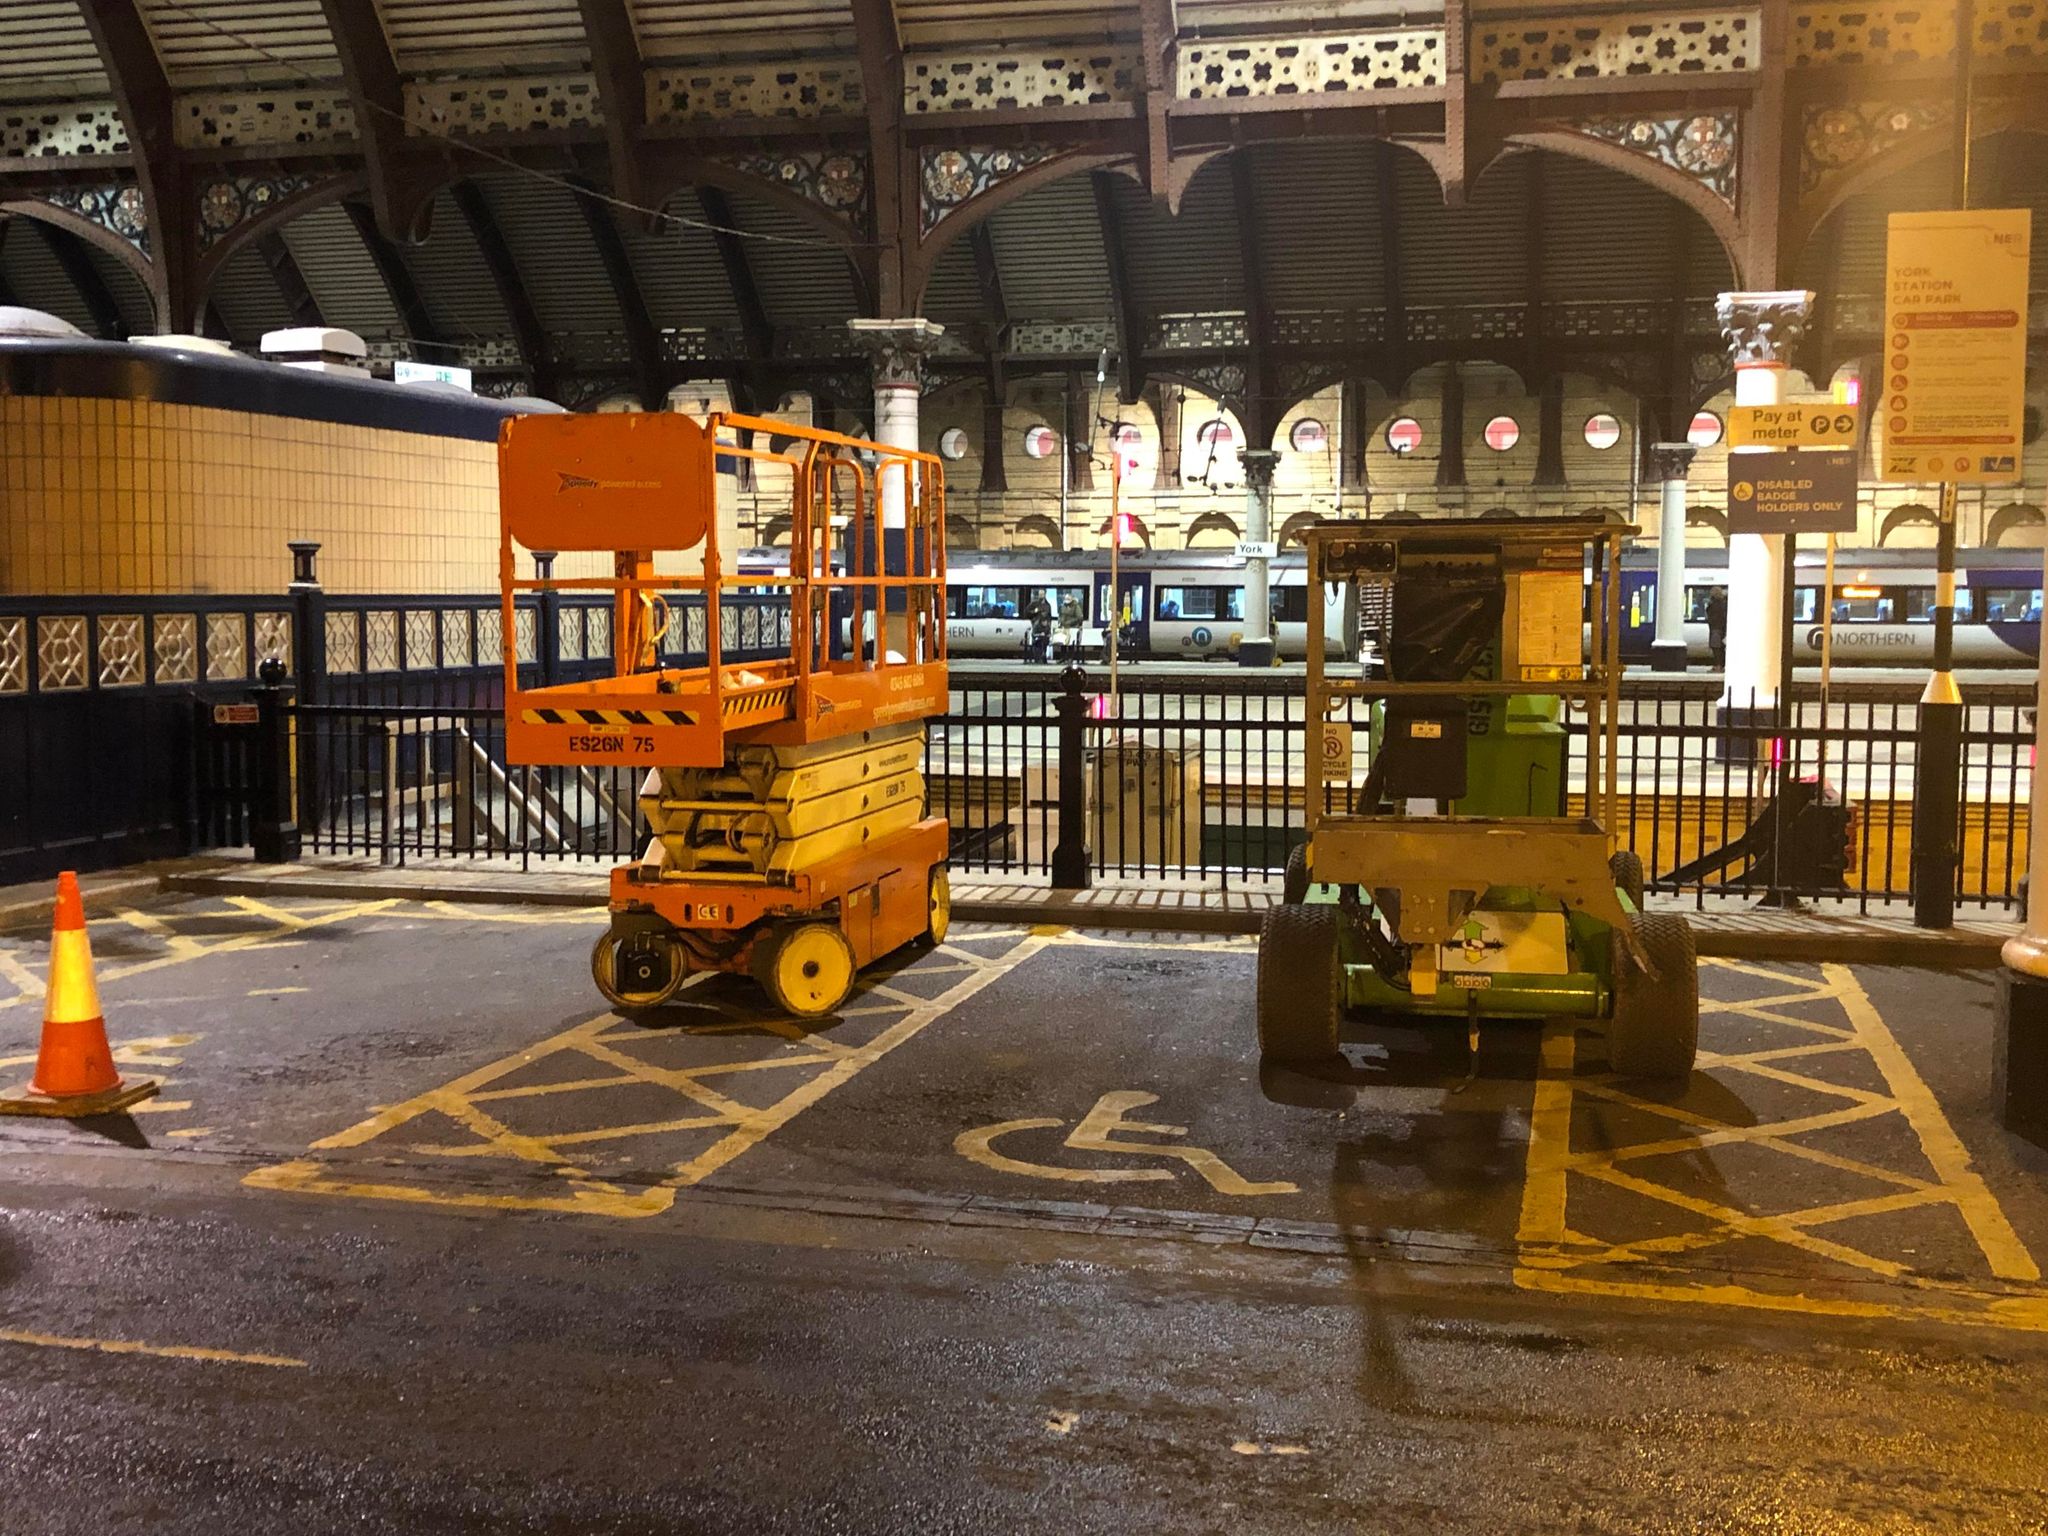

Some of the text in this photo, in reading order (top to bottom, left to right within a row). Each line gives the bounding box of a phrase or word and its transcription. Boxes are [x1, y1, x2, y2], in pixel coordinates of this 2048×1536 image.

[1893, 267, 1932, 278] YORK
[1893, 280, 1953, 291] STATION
[1892, 294, 1962, 305] CAR PARK
[1752, 409, 1803, 424] Pay at
[1752, 427, 1801, 439] meter
[1756, 480, 1814, 490] DISABLED
[1756, 491, 1797, 501] BADGE
[1756, 501, 1843, 512] HOLDERS ONLY
[1239, 544, 1263, 554] York
[1835, 632, 1916, 646] NORTHERN
[1325, 728, 1338, 736] NO
[569, 736, 655, 752] ES26N 75
